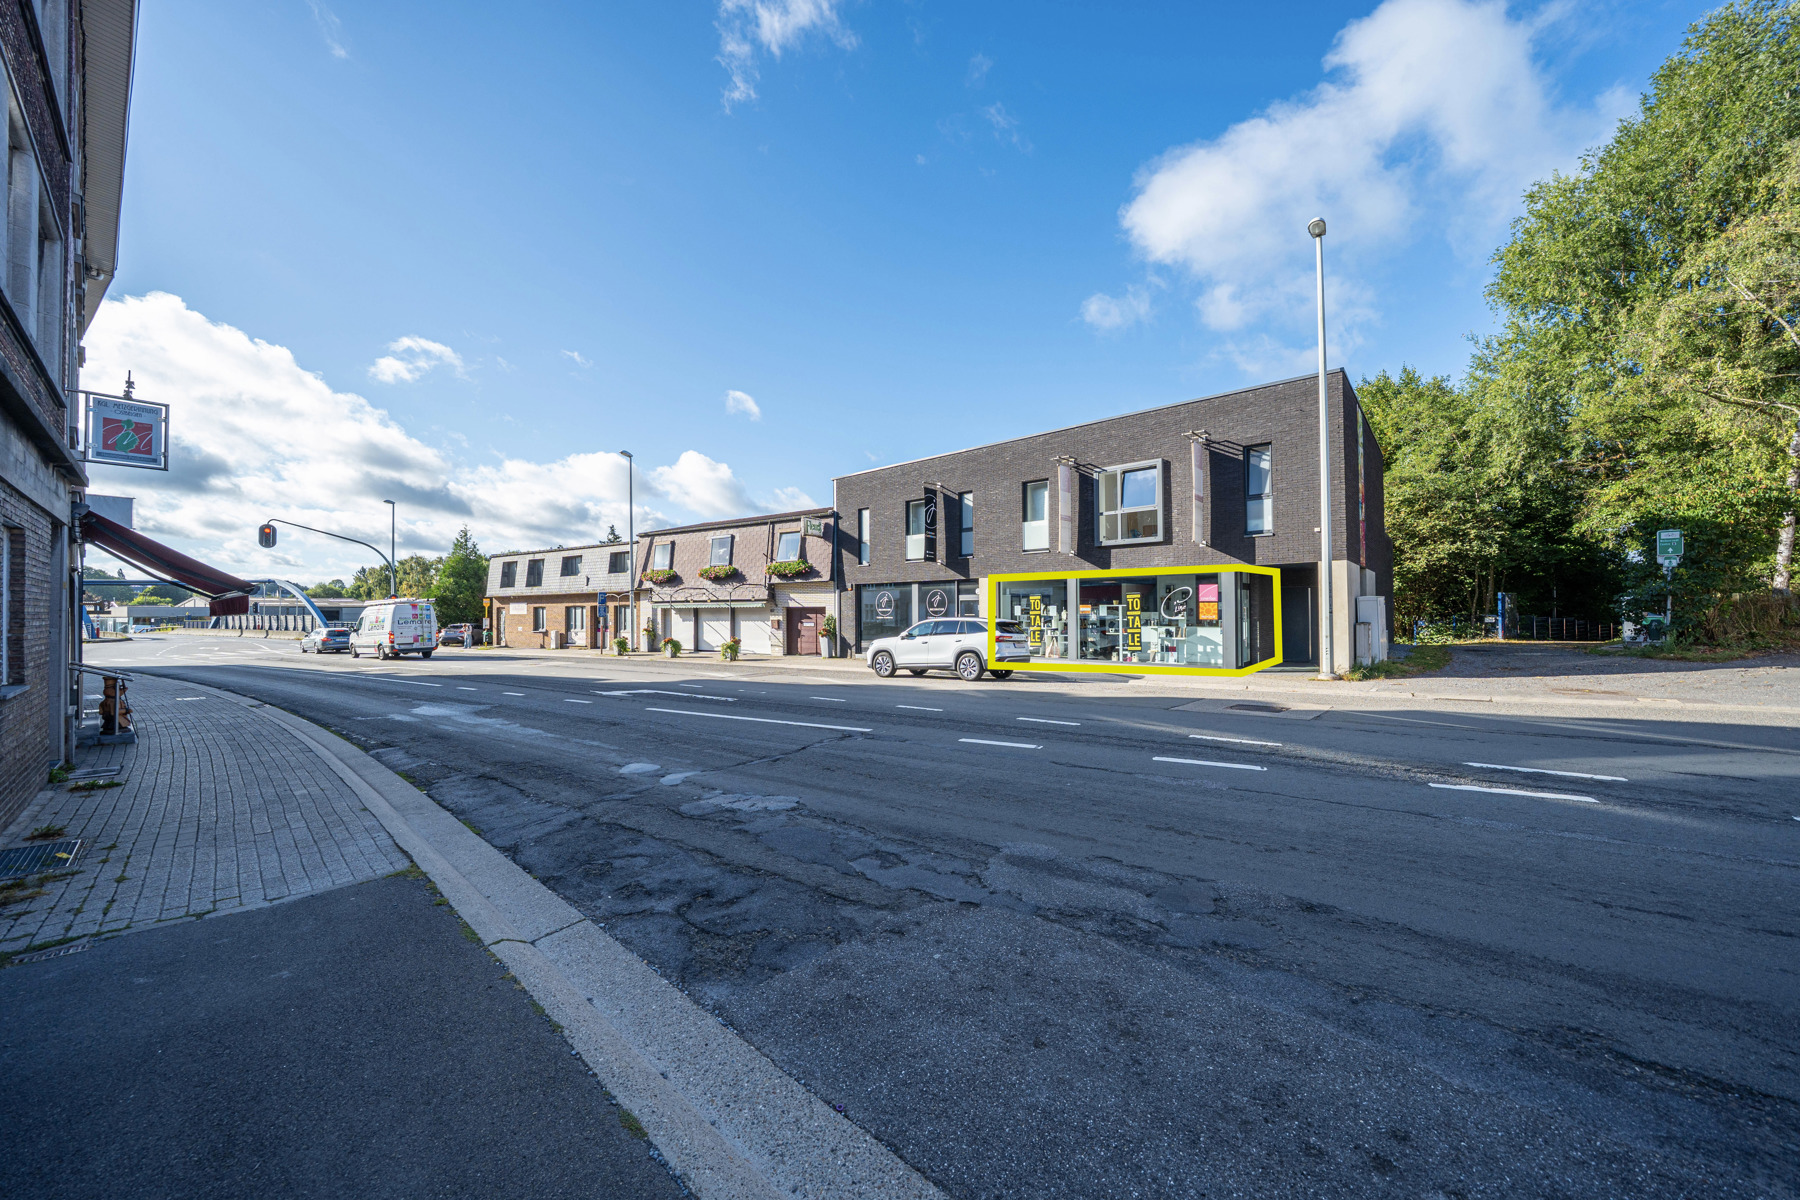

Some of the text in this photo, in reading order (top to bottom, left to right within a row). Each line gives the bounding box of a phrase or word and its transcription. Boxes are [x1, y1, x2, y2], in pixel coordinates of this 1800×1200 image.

[600, 594, 605, 603] P
[1030, 600, 1040, 610] TO
[1127, 599, 1140, 610] TO
[397, 617, 431, 625] Lemare
[1030, 616, 1041, 626] TA
[1128, 616, 1141, 628] TA
[1030, 632, 1040, 641] LE
[1128, 634, 1140, 646] LE
